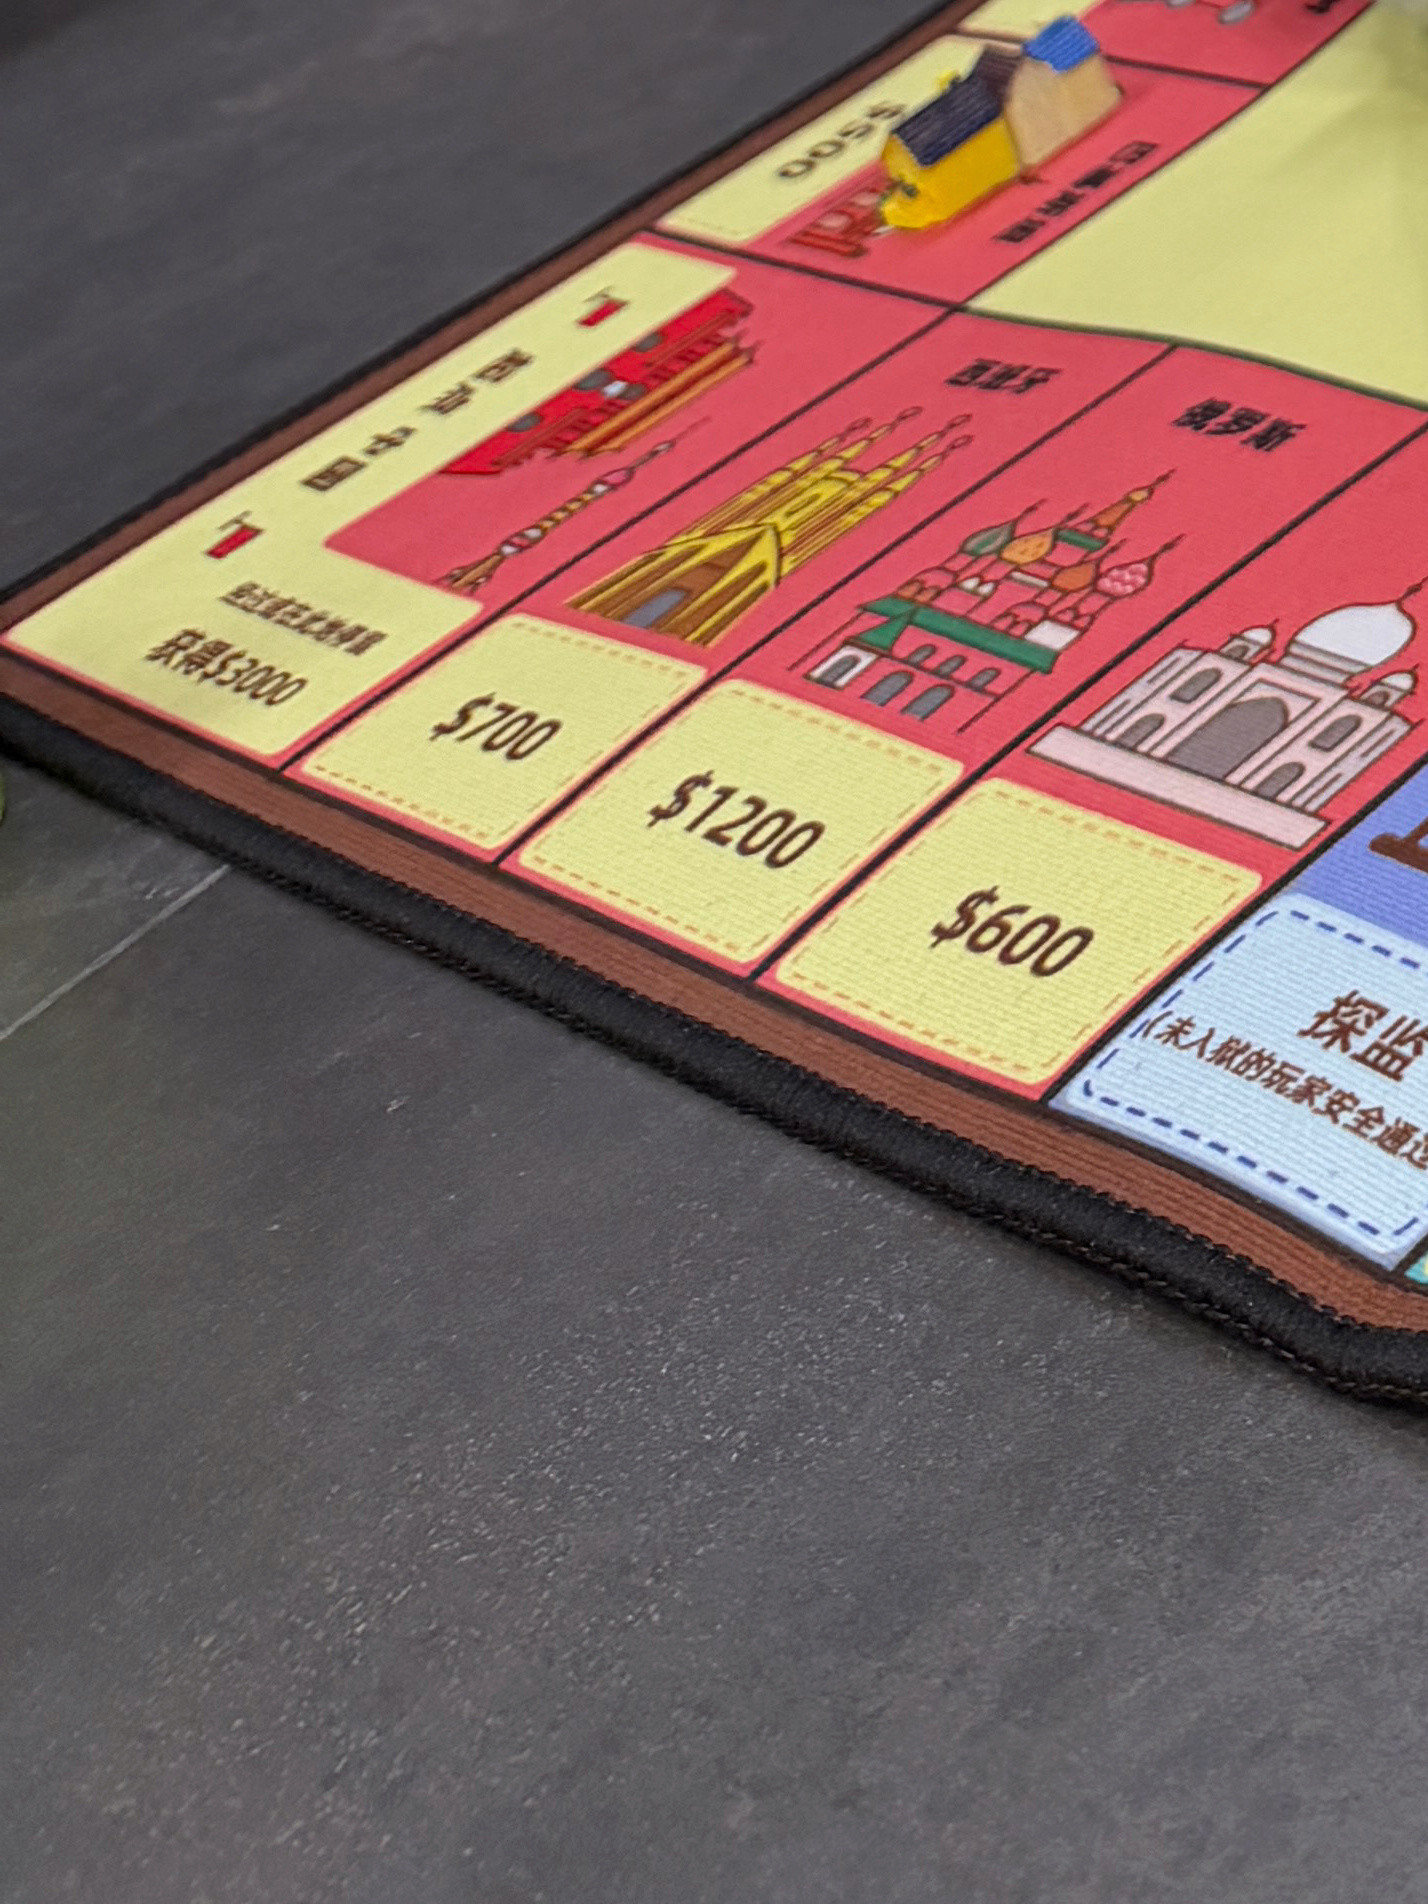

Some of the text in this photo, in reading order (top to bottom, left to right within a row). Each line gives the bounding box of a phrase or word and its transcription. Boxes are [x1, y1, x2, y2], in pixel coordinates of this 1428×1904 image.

[430, 692, 563, 761] $700
[646, 770, 826, 869] $1200
[929, 886, 1095, 977] $600
